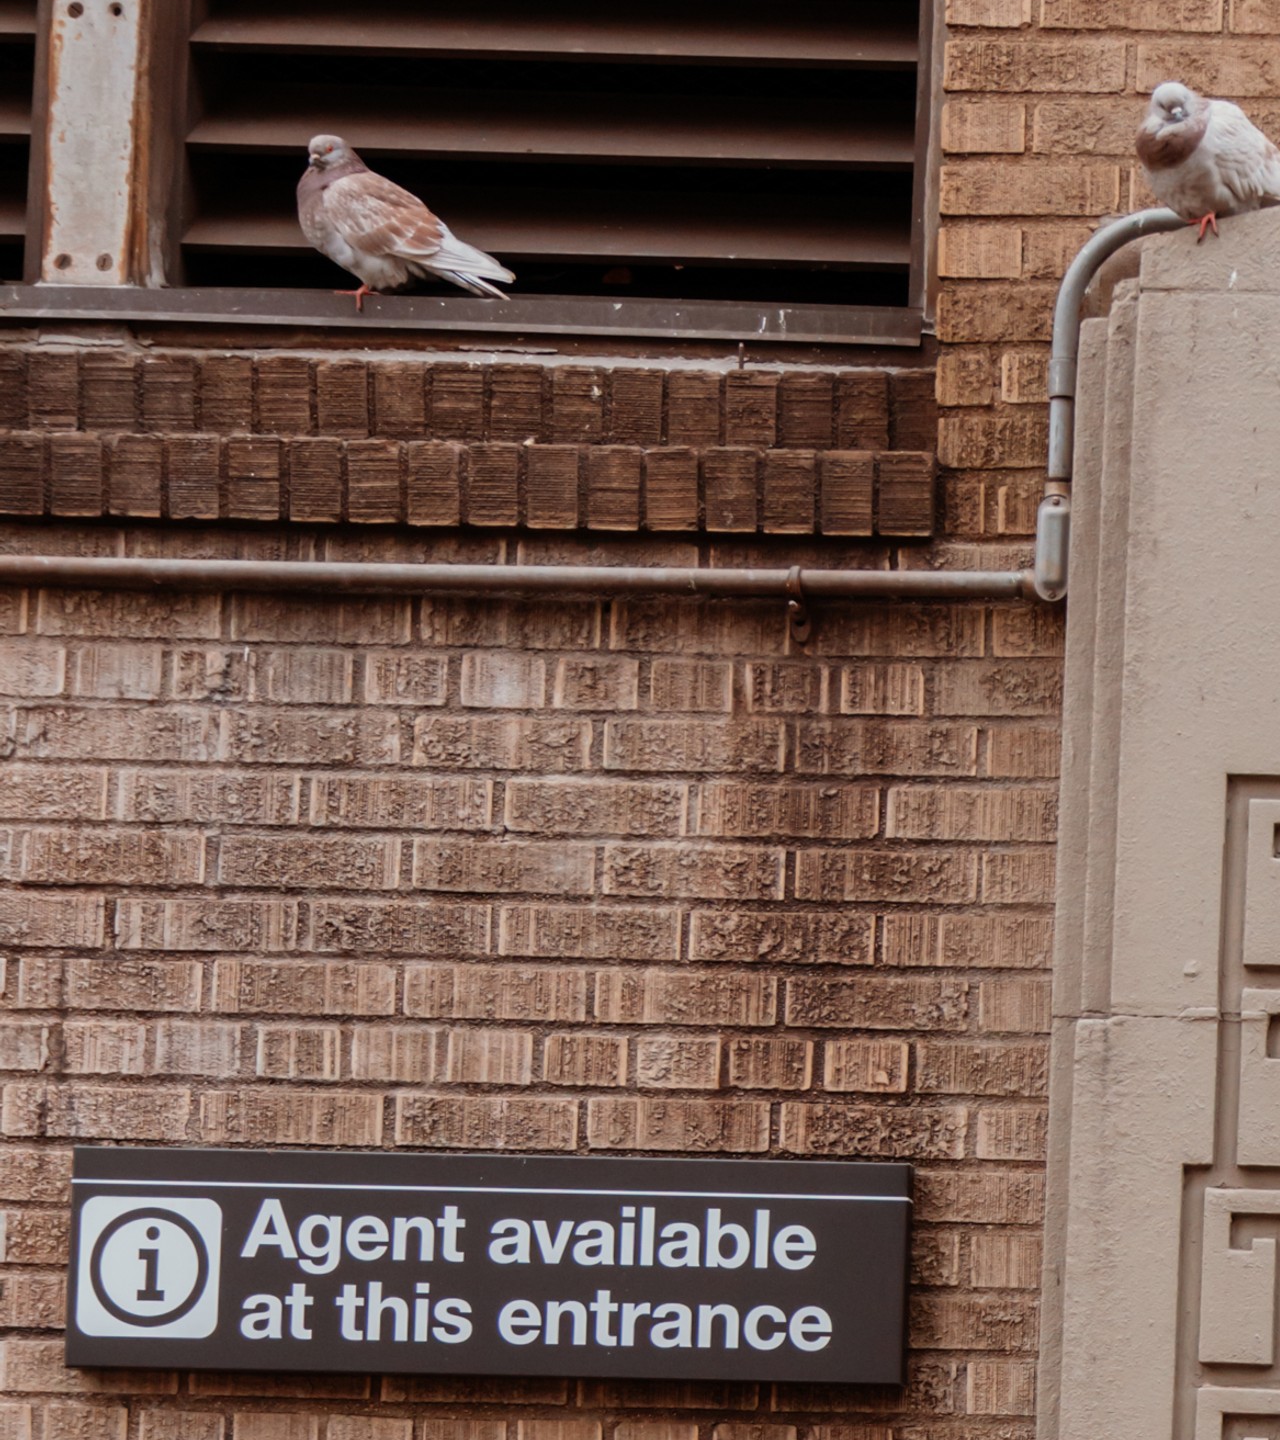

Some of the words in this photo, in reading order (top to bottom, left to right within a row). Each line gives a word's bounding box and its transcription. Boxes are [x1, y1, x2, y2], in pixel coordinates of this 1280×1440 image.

[240, 1197, 467, 1275] Agent
[488, 1204, 818, 1272] available
[239, 1282, 314, 1342] at
[333, 1280, 474, 1346] this
[497, 1297, 834, 1353] entrance
